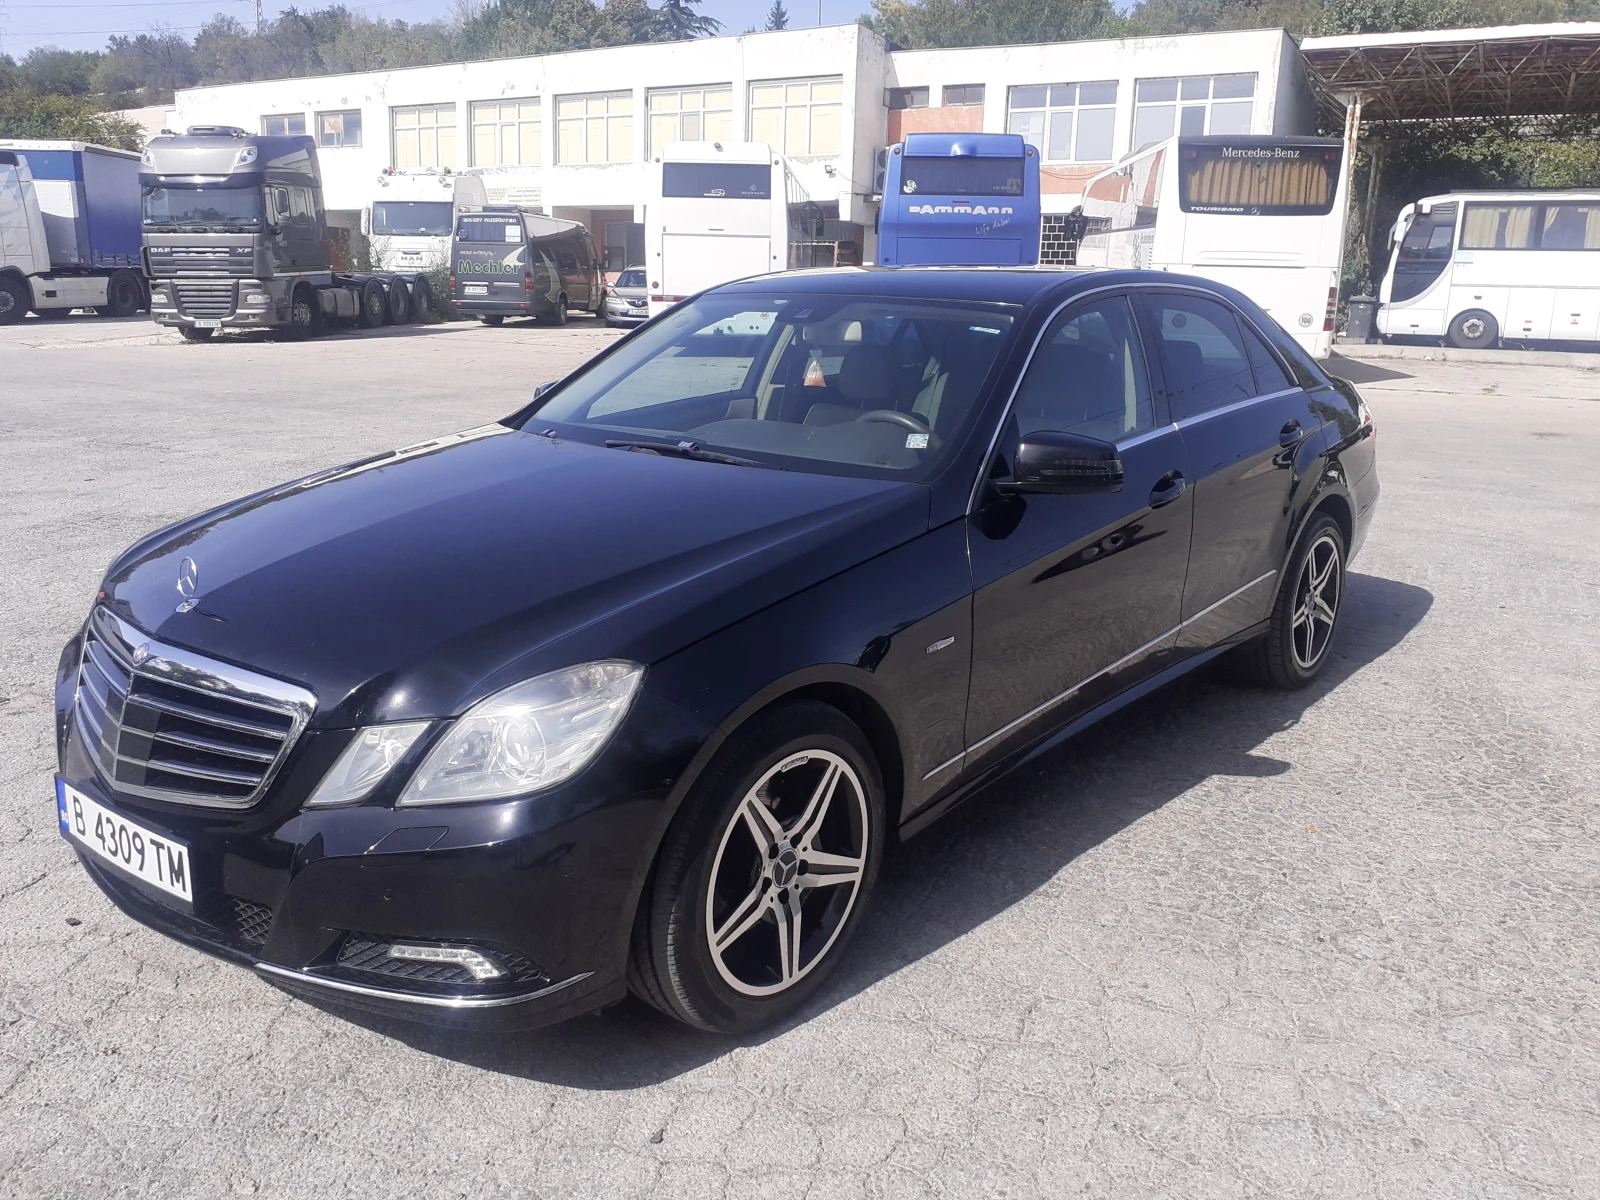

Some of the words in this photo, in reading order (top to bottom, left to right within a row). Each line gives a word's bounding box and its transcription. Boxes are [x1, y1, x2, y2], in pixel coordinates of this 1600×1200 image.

[1221, 147, 1300, 158] Mercedes-Benz
[457, 259, 521, 275] Mechler
[1301, 316, 1312, 324] 100
[61, 810, 69, 824] BG
[73, 795, 86, 837] B
[95, 811, 145, 872] 4309
[149, 837, 187, 893] TM
